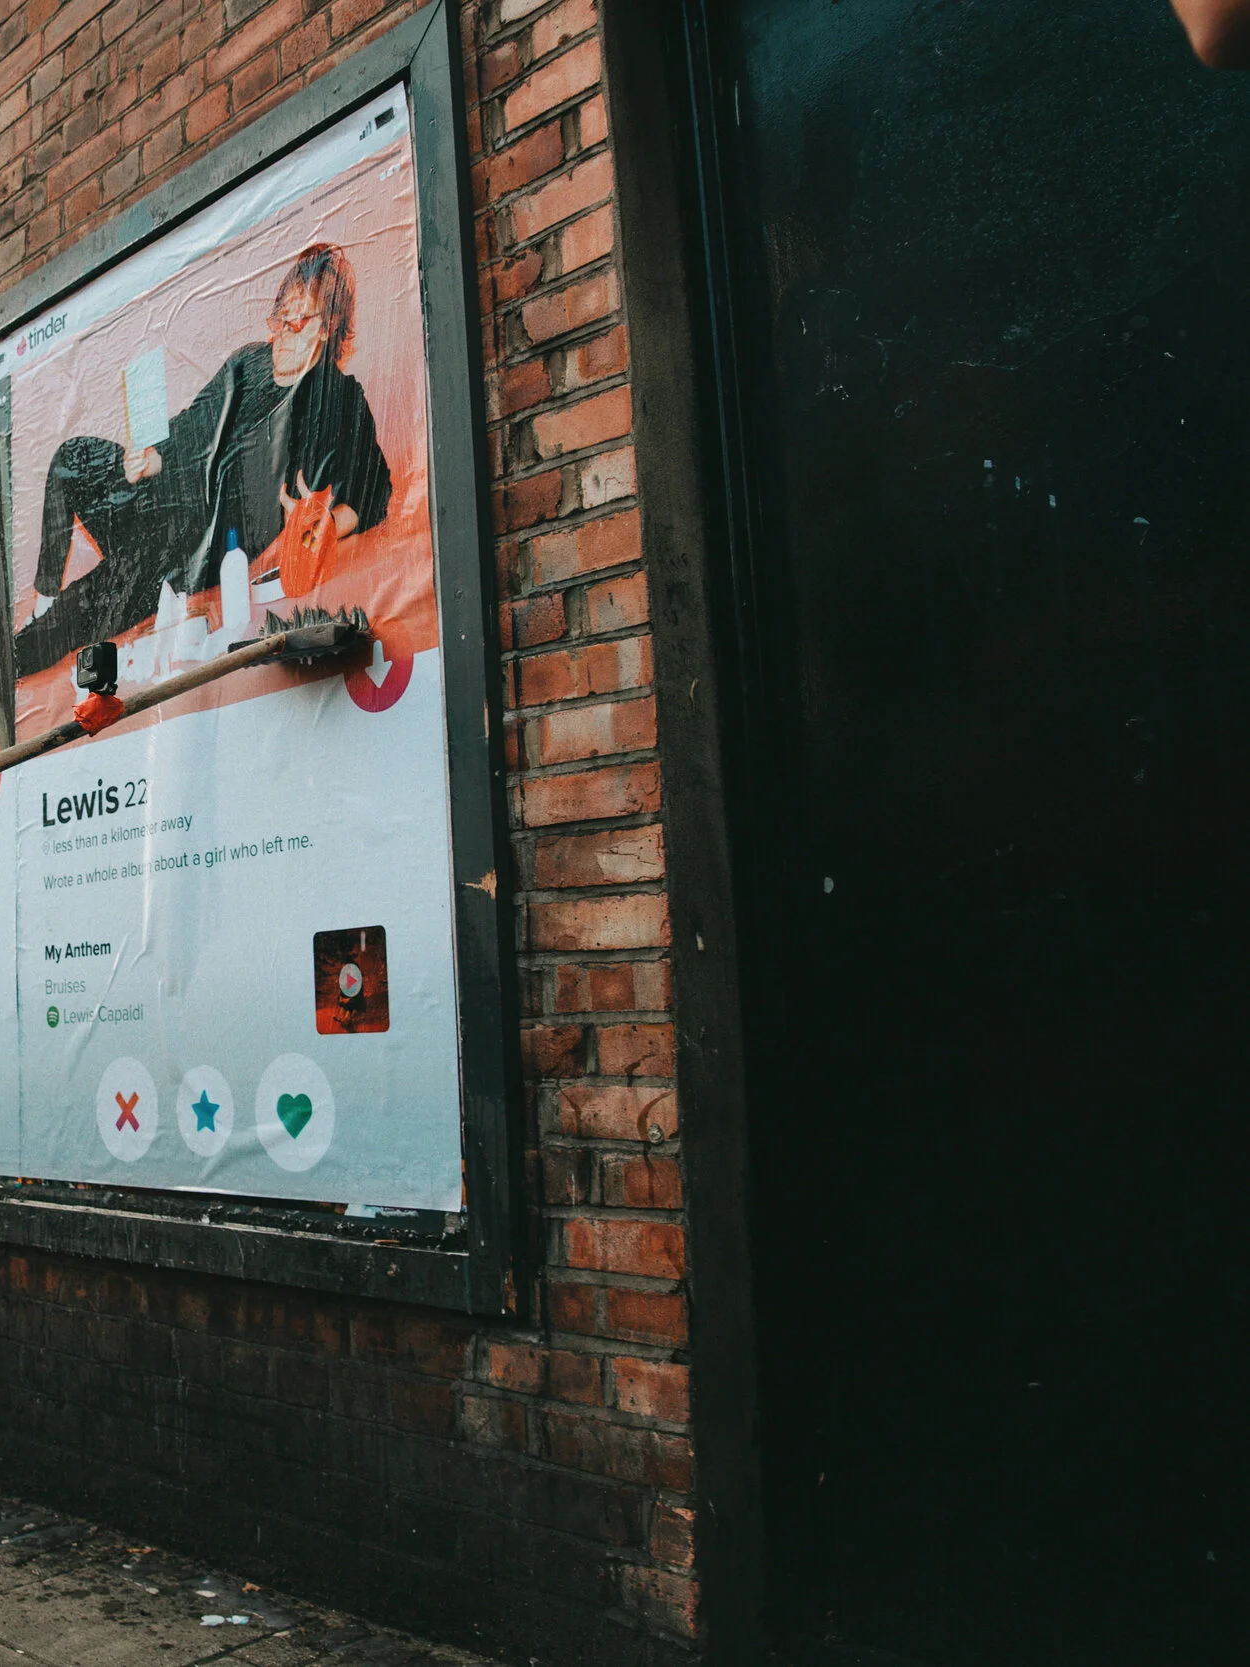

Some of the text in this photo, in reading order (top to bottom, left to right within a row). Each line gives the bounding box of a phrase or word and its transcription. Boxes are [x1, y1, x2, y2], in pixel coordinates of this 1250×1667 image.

[28, 312, 68, 350] tinder
[42, 778, 148, 828] Lewis 22
[53, 815, 193, 855] less than a kilomeer away
[43, 872, 74, 890] Wrote
[76, 874, 83, 886] a
[85, 866, 118, 883] whole
[154, 852, 188, 872] about
[193, 853, 201, 866] a
[204, 845, 227, 868] girl
[229, 842, 258, 860] who
[262, 835, 284, 855] left
[287, 834, 313, 851] me.
[45, 940, 111, 963] My Anthem
[45, 978, 86, 995] Bruises
[98, 1003, 144, 1025] Capaldi
